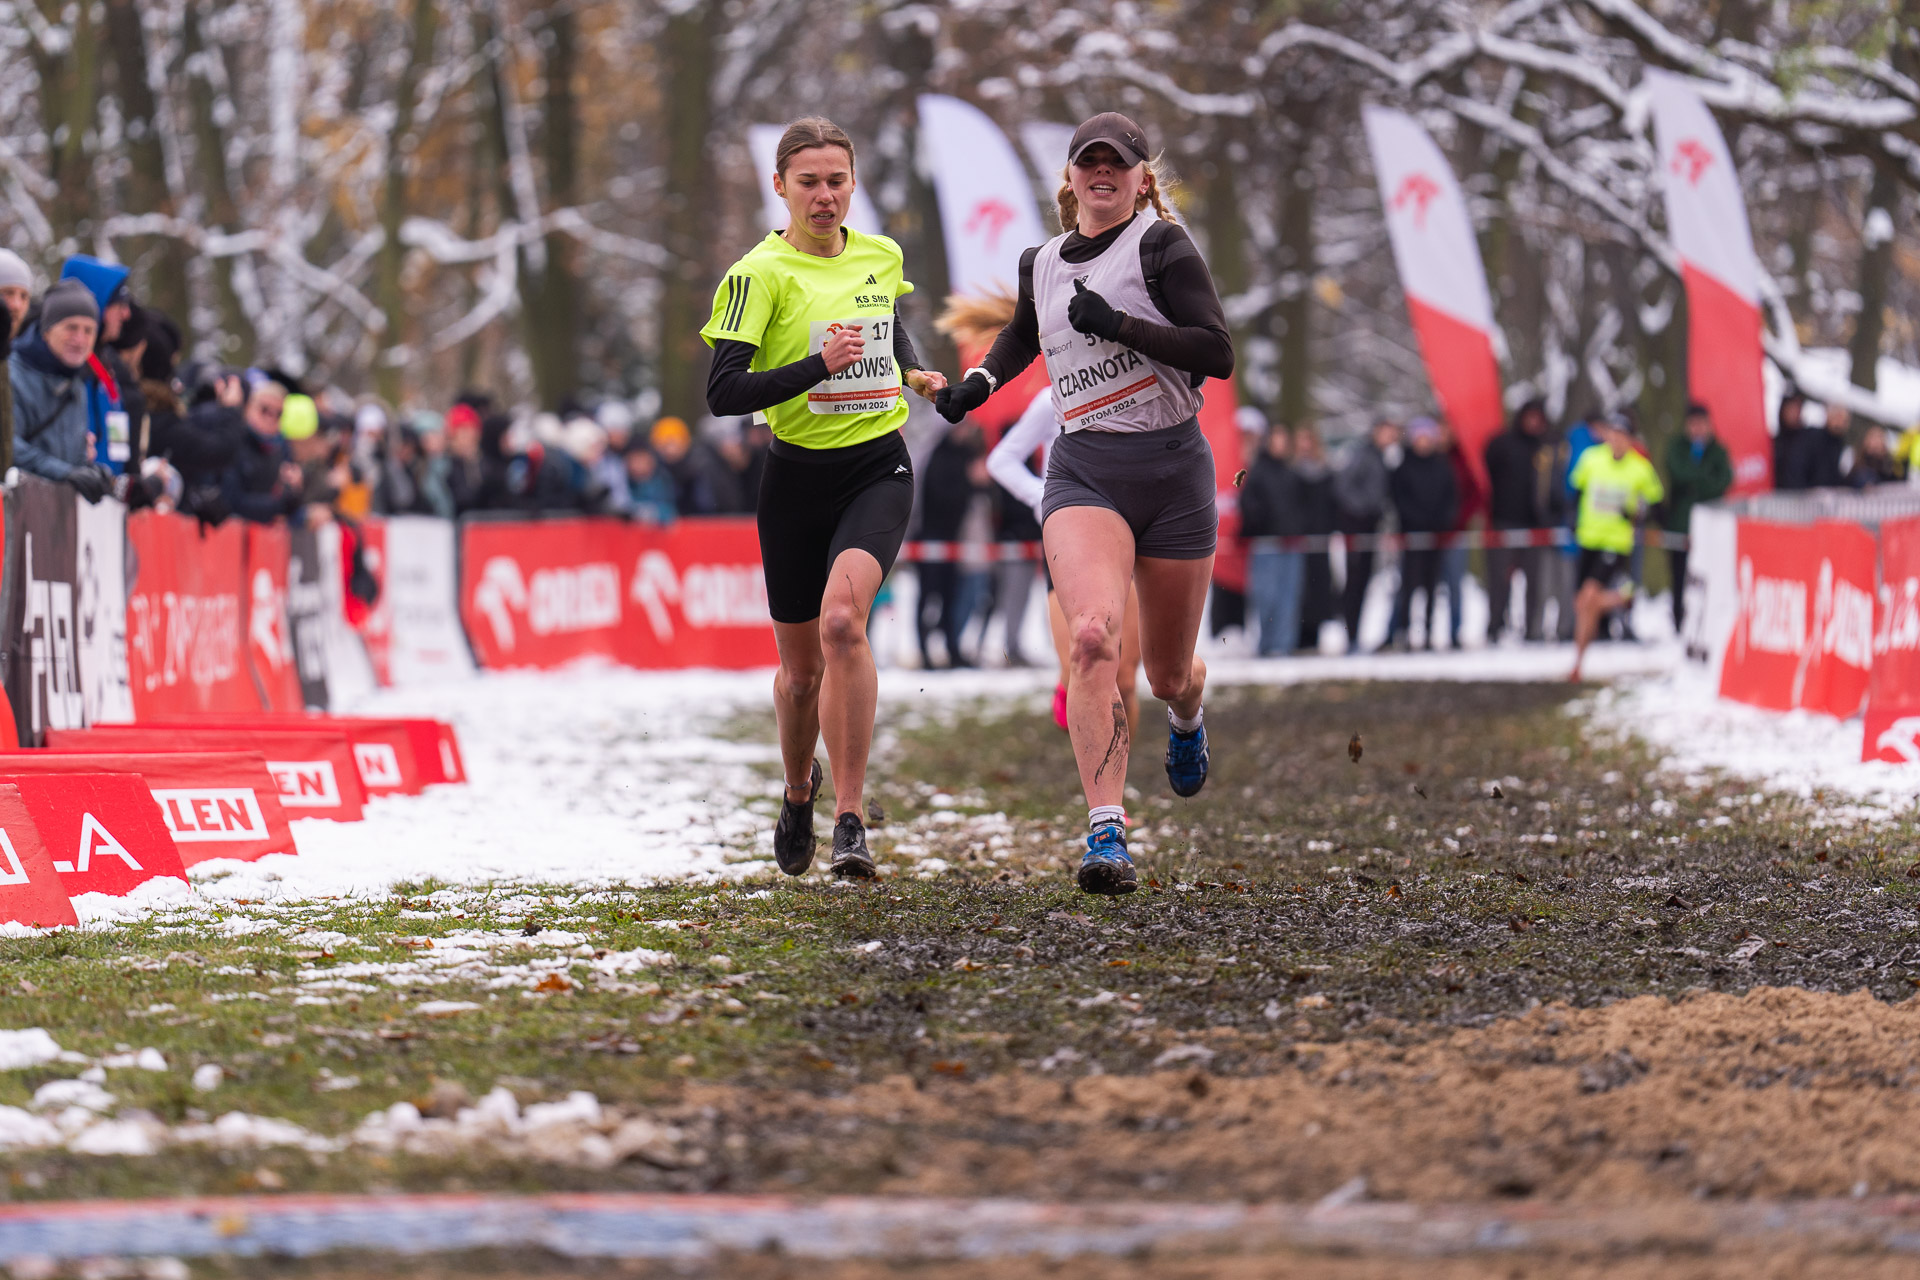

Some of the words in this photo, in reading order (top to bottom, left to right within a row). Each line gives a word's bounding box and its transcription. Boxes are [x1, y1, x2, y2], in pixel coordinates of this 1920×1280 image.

[854, 295, 870, 304] KS
[871, 294, 890, 304] SMS
[872, 321, 889, 341] 17
[1058, 349, 1144, 398] CZARNOTA
[834, 402, 867, 412] BYTOM
[868, 401, 888, 410] 2024
[1080, 408, 1113, 426] BYTOM
[1112, 397, 1137, 414] 2024
